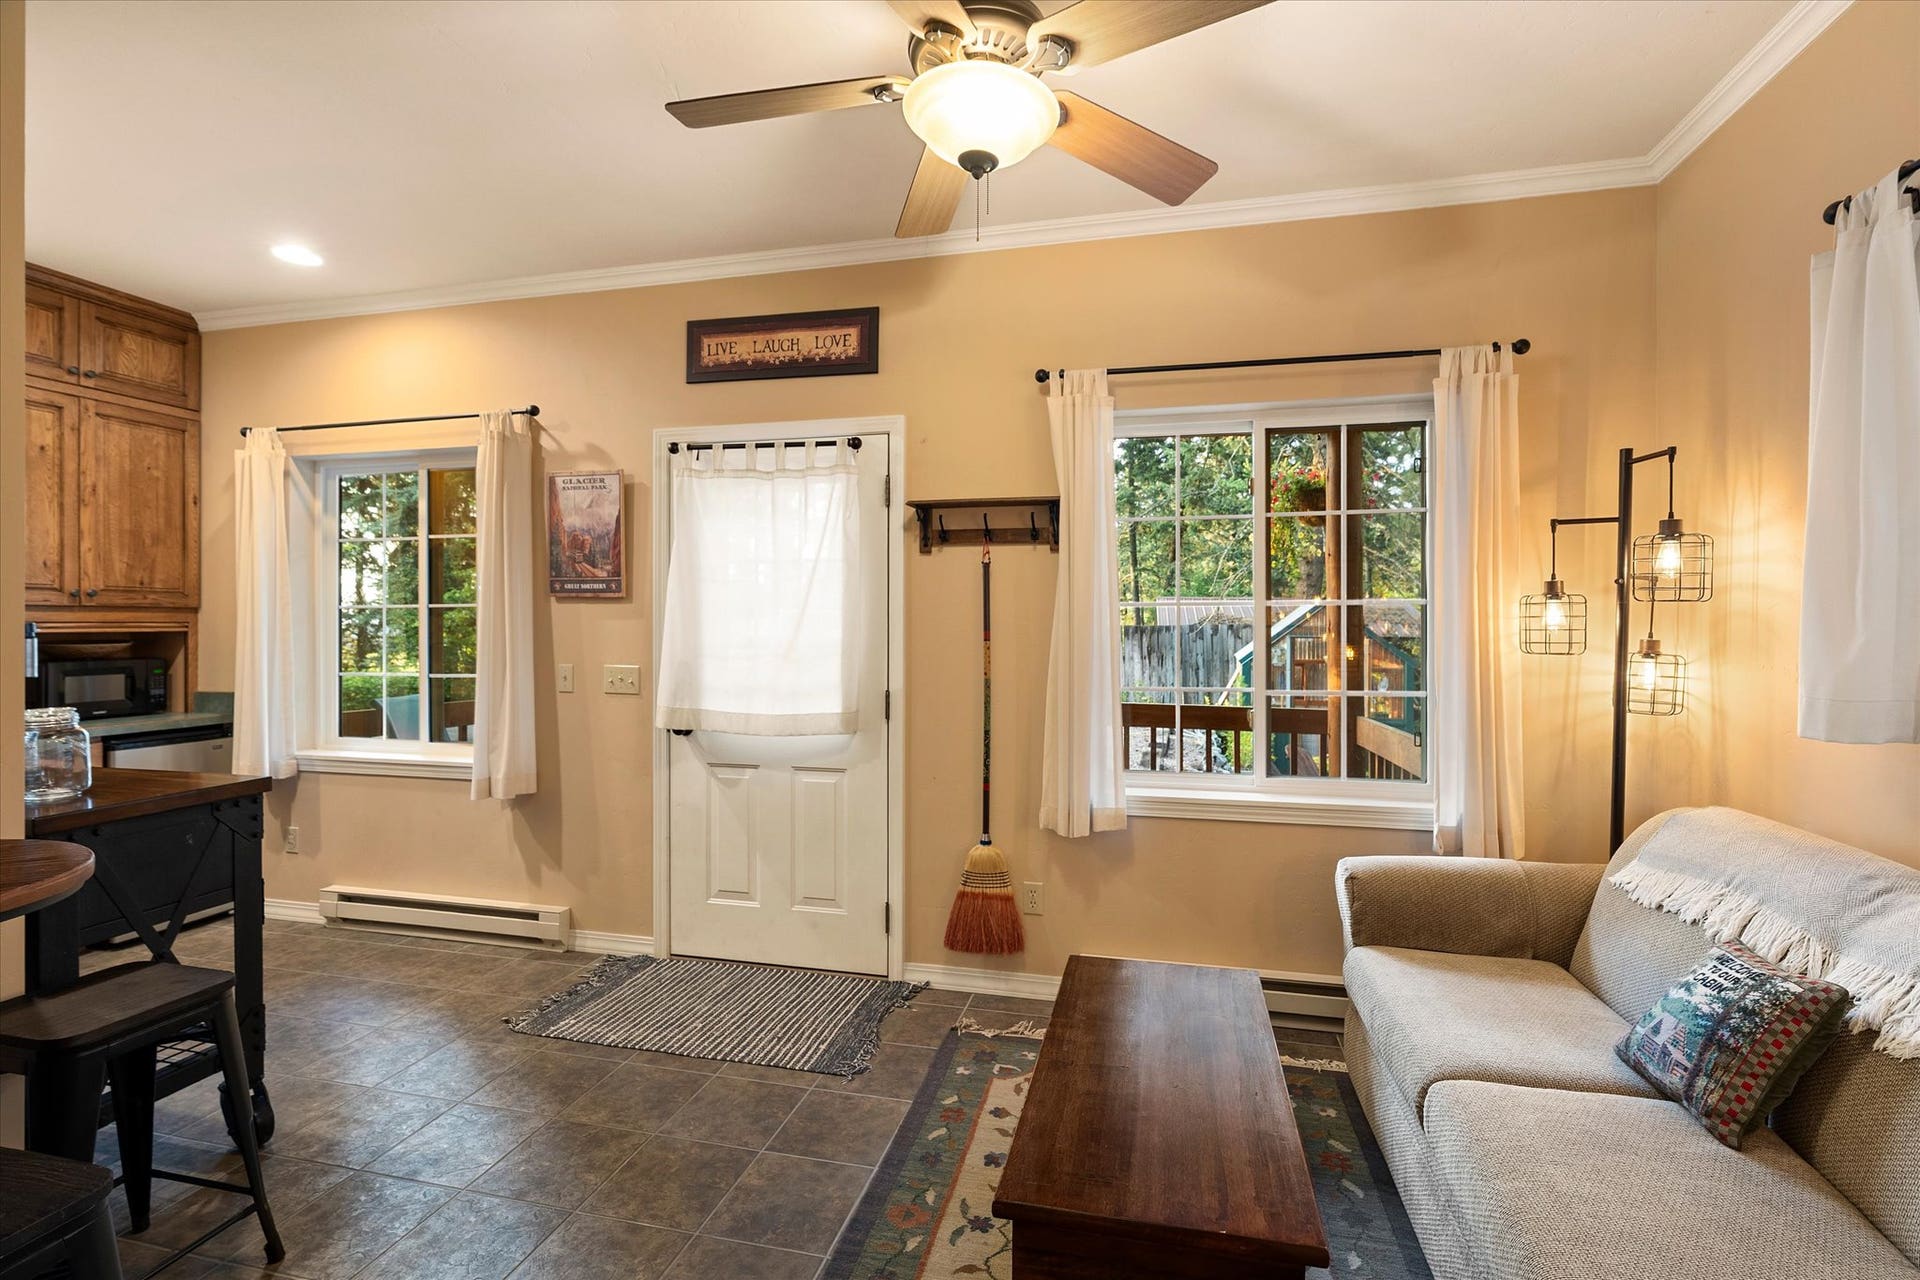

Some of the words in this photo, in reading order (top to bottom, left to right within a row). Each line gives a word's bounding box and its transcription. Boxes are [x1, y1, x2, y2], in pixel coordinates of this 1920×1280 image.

[707, 341, 738, 357] LIVE
[753, 338, 800, 354] LAUGH
[815, 333, 852, 350] LOVE
[562, 477, 607, 485] GLACIER
[1708, 964, 1723, 974] TO
[1718, 971, 1743, 985] OUR
[1713, 953, 1767, 982] WELCOME
[1693, 972, 1729, 995] CABIN
